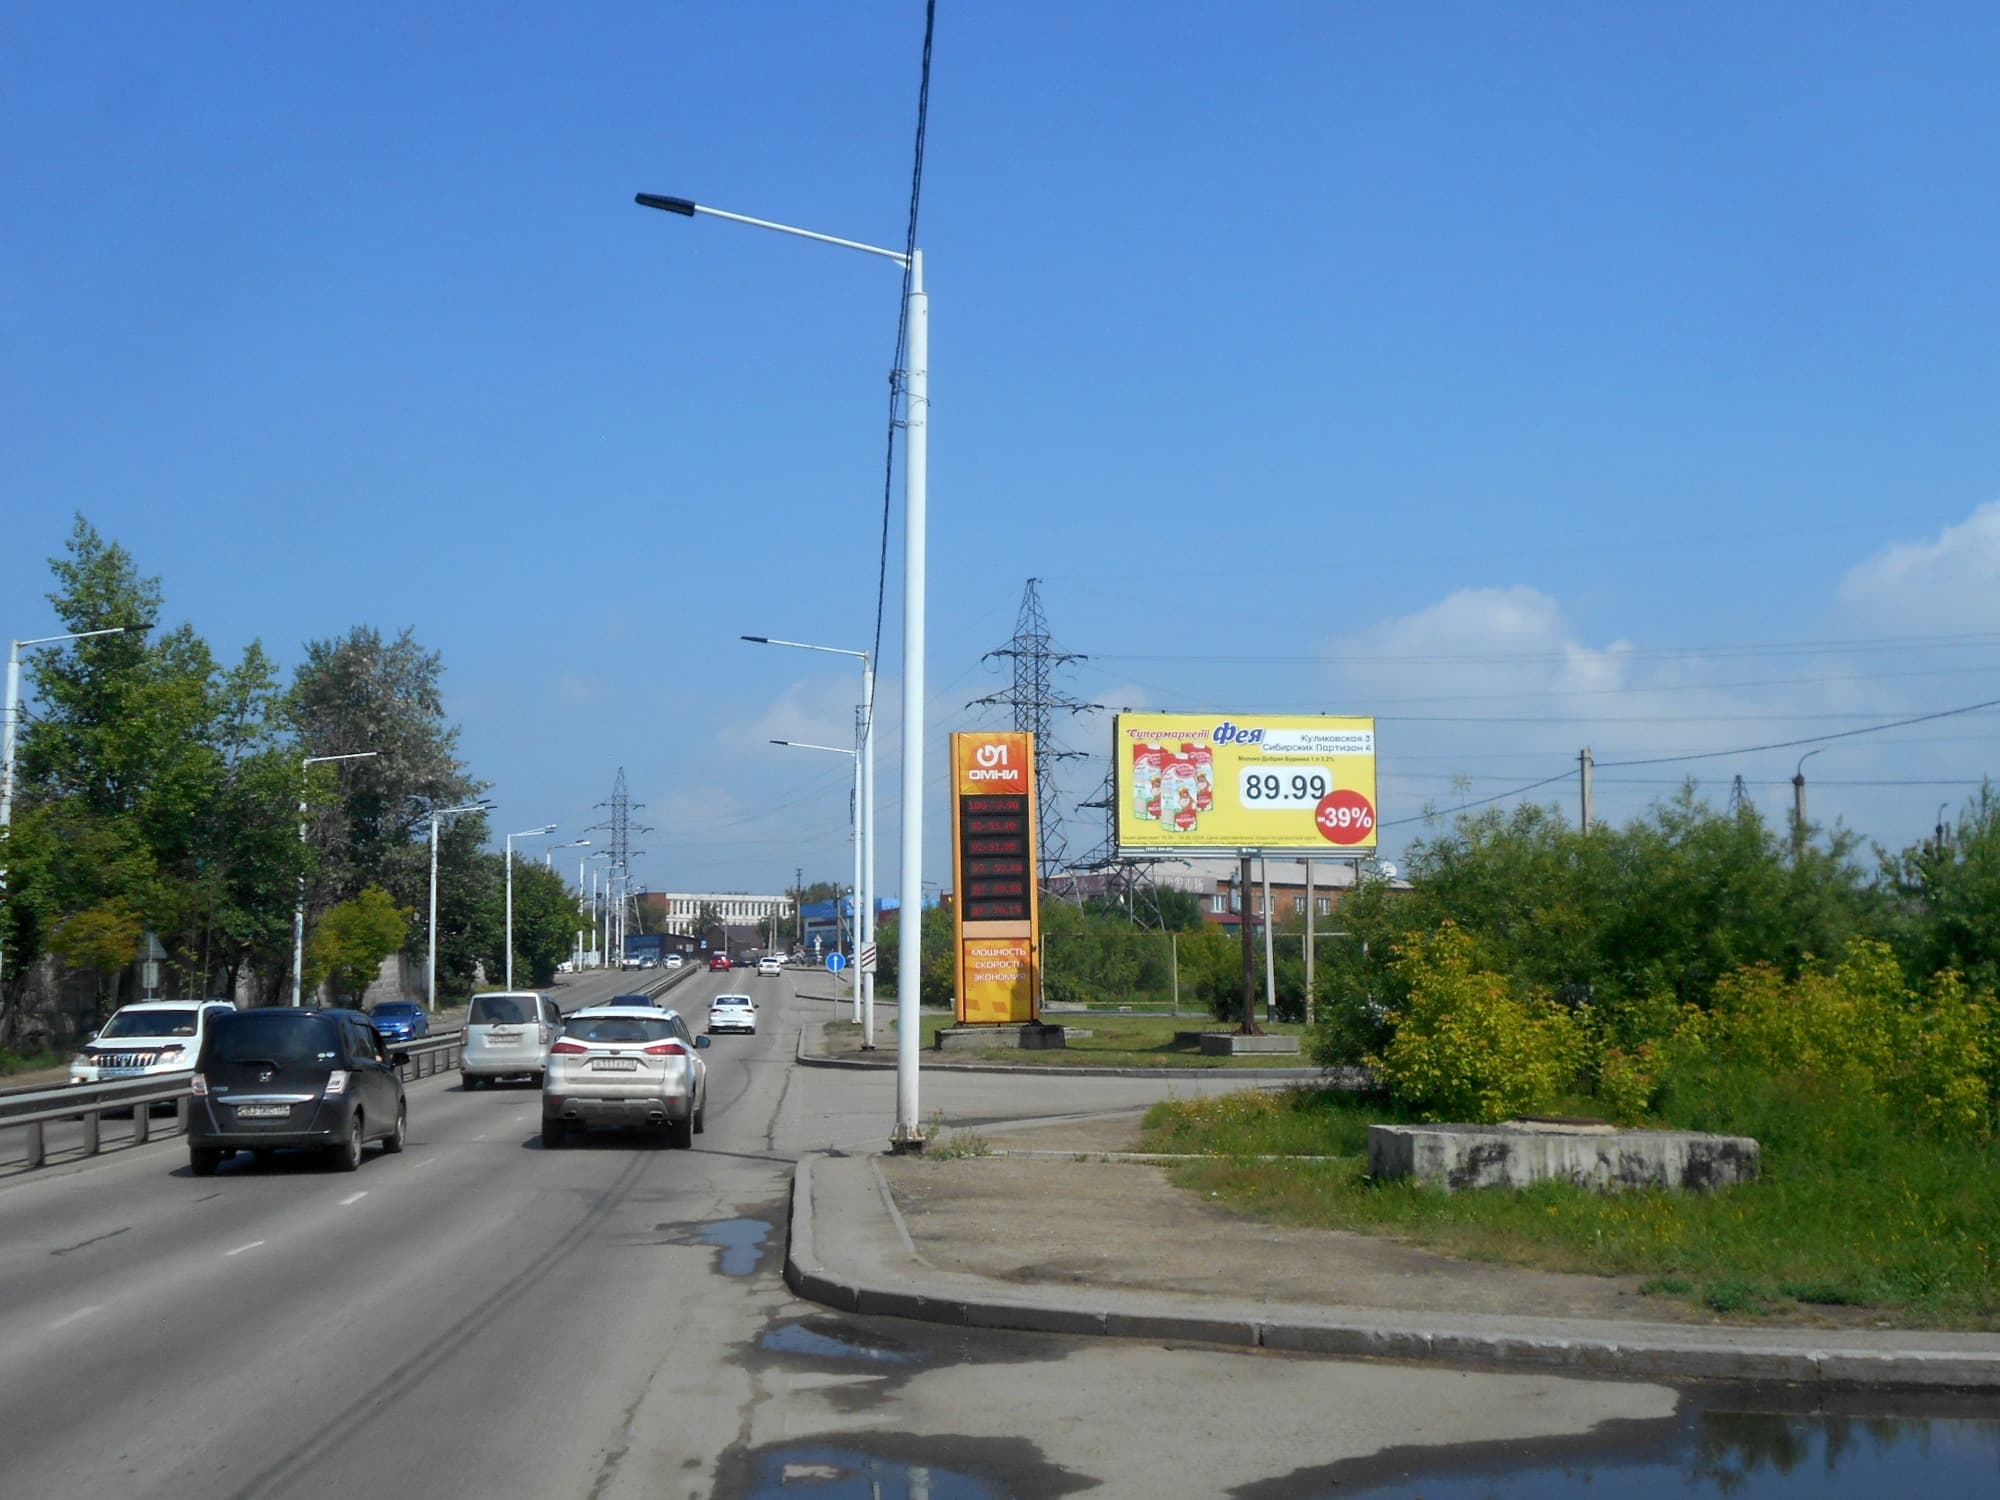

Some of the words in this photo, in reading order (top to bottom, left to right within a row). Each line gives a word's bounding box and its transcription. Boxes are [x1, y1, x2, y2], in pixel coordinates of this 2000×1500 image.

[1127, 729, 1209, 740] Супермаркет
[1213, 722, 1263, 744] Фея
[1301, 735, 1363, 743] Куликовская
[1263, 744, 1313, 752] Сибирских
[1316, 744, 1363, 752] Партизан
[969, 769, 1018, 781] ОМНИ
[1246, 774, 1326, 800] 89.99
[1317, 807, 1373, 828] -39%
[975, 960, 1024, 969] СКОРОСТЬ
[974, 973, 1026, 982] ЭКОНОМИЯ
